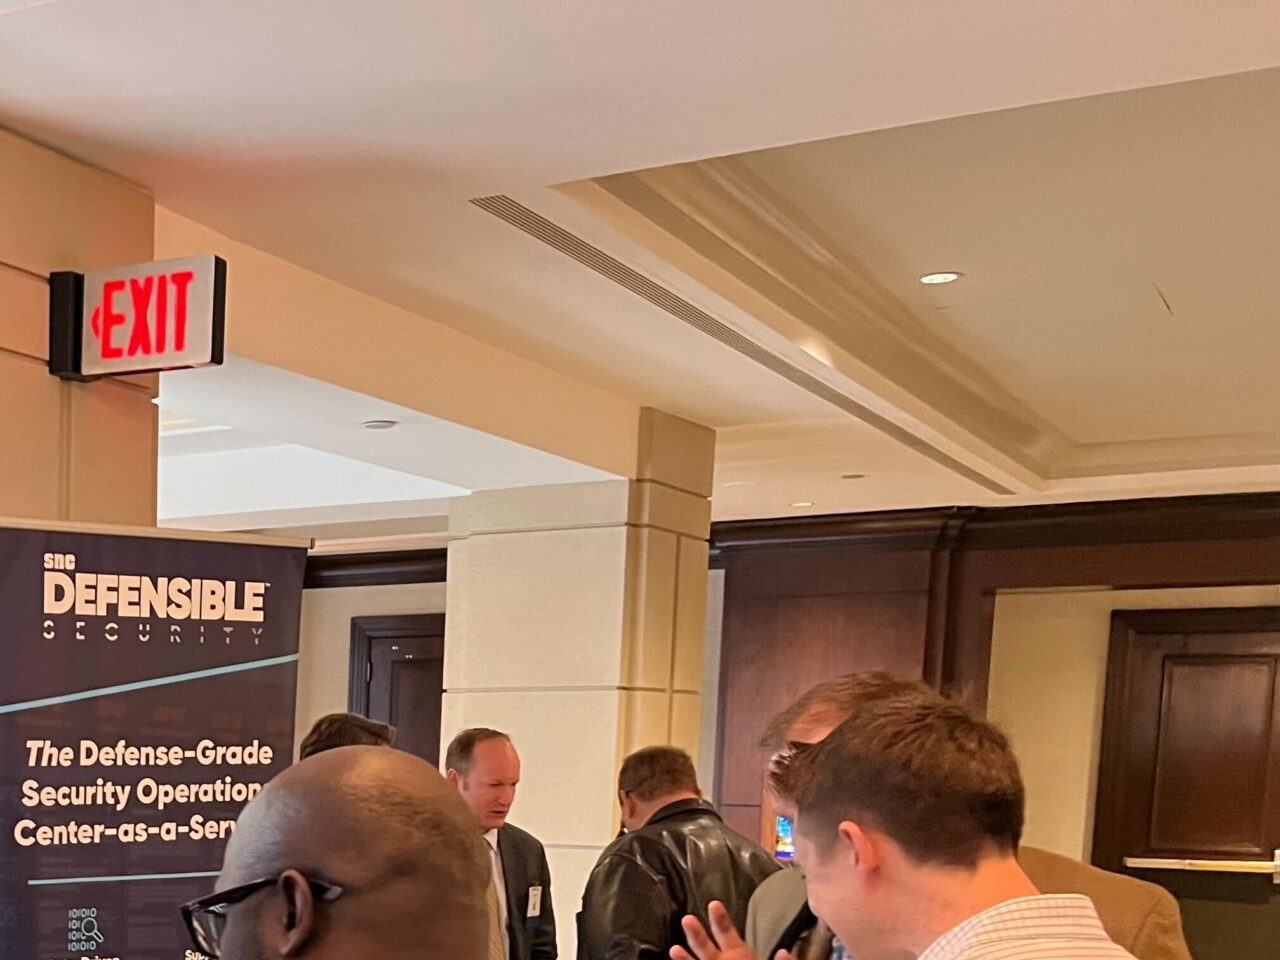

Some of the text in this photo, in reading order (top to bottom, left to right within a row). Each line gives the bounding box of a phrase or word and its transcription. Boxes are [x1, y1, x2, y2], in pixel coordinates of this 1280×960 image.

[100, 271, 194, 359] EXIT
[43, 570, 265, 622] DEFENSIBLE
[42, 619, 263, 645] SECURITY
[25, 739, 273, 767] The Defense-Grade
[21, 777, 131, 811] Security
